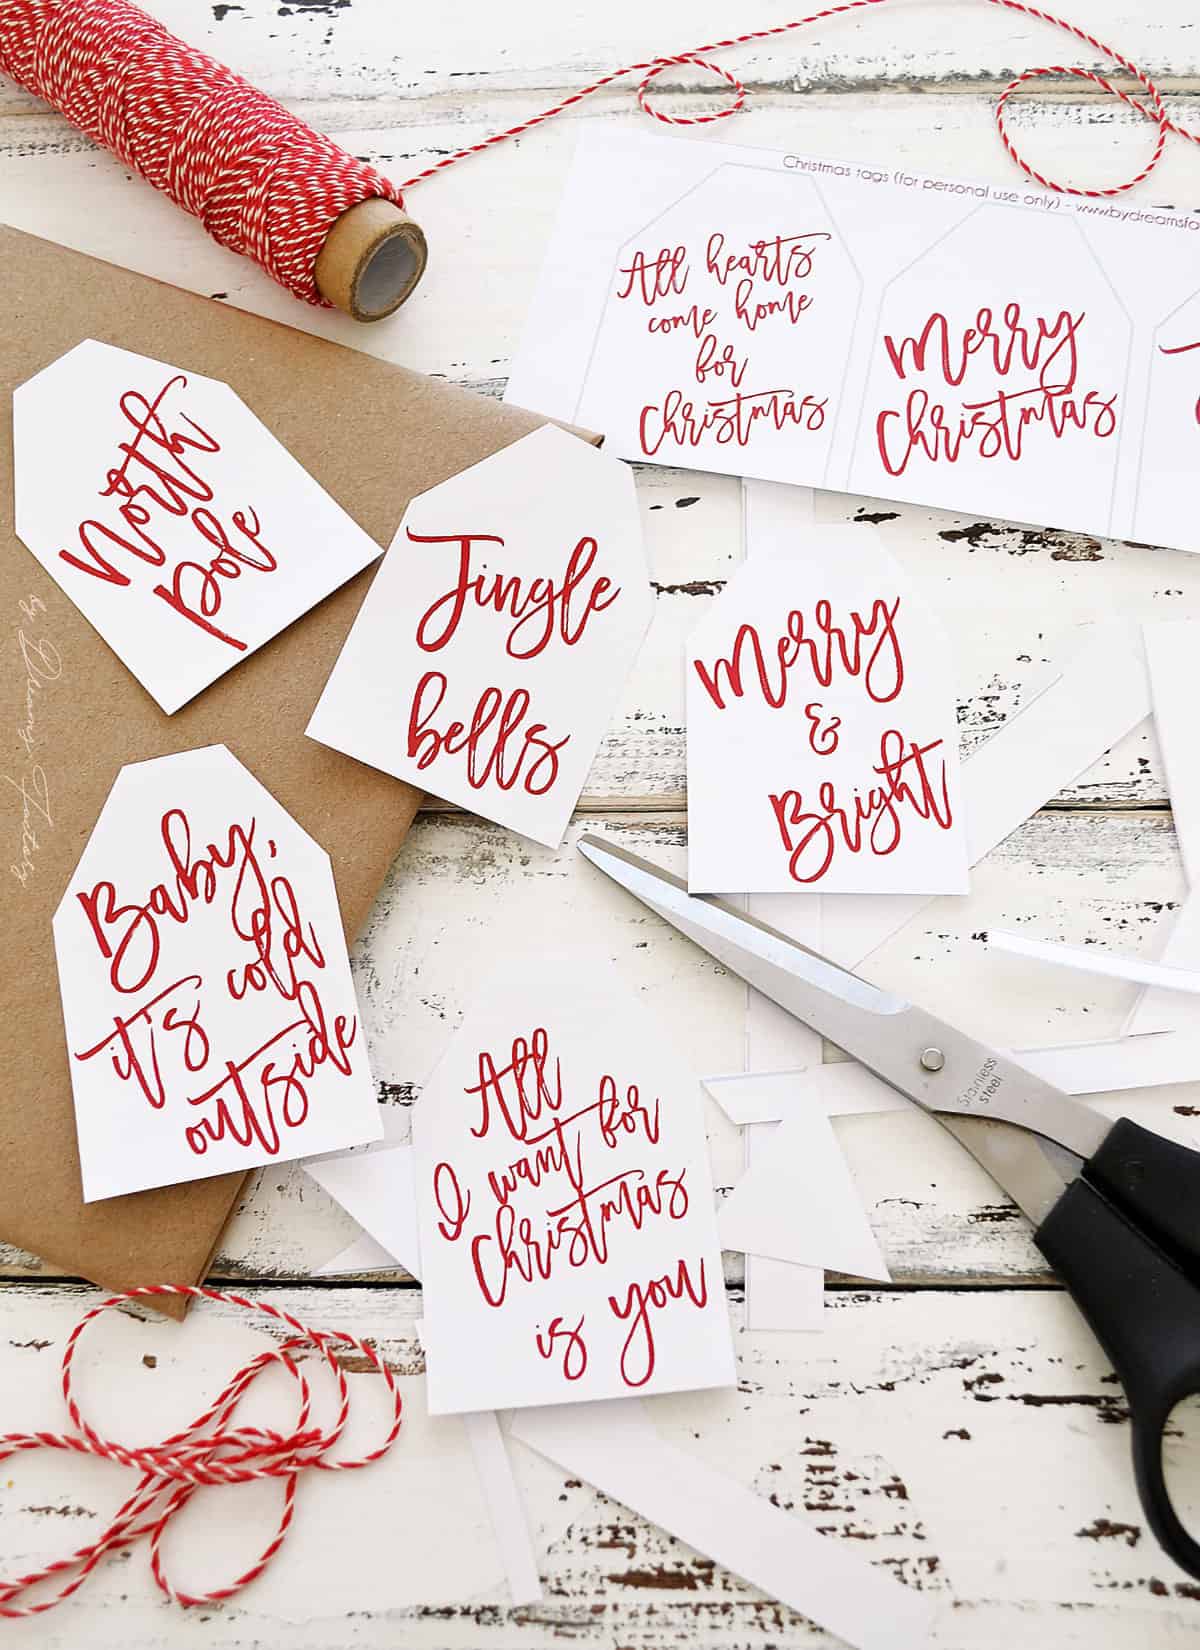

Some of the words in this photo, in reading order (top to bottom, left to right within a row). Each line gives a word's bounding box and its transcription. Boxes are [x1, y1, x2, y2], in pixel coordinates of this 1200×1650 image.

[783, 155, 851, 177] Christmas
[856, 168, 890, 184] tags
[893, 171, 919, 188] (for
[922, 179, 989, 199] personal
[992, 191, 1020, 204] use
[1023, 194, 1060, 211] only)
[616, 246, 690, 306] All
[706, 233, 832, 286] hearts
[648, 304, 718, 338] come
[735, 278, 814, 331] home
[695, 334, 749, 388] for
[639, 390, 829, 456] Christmas
[876, 384, 1118, 477] Christmas
[406, 526, 622, 660] Jingle
[407, 671, 571, 796] bells
[804, 702, 842, 756] &
[768, 729, 953, 884] Bright
[76, 808, 278, 994] Baby,
[75, 974, 210, 1110] it's
[227, 875, 326, 1001] cold
[185, 979, 358, 1156] outside
[464, 1028, 563, 1142] All
[958, 1056, 998, 1106] Stainless
[979, 1073, 1004, 1104] steel
[488, 1098, 620, 1205] want
[599, 1075, 660, 1149] for
[471, 1168, 690, 1308] Christmas
[535, 1313, 588, 1381] is
[608, 1257, 708, 1388] you
